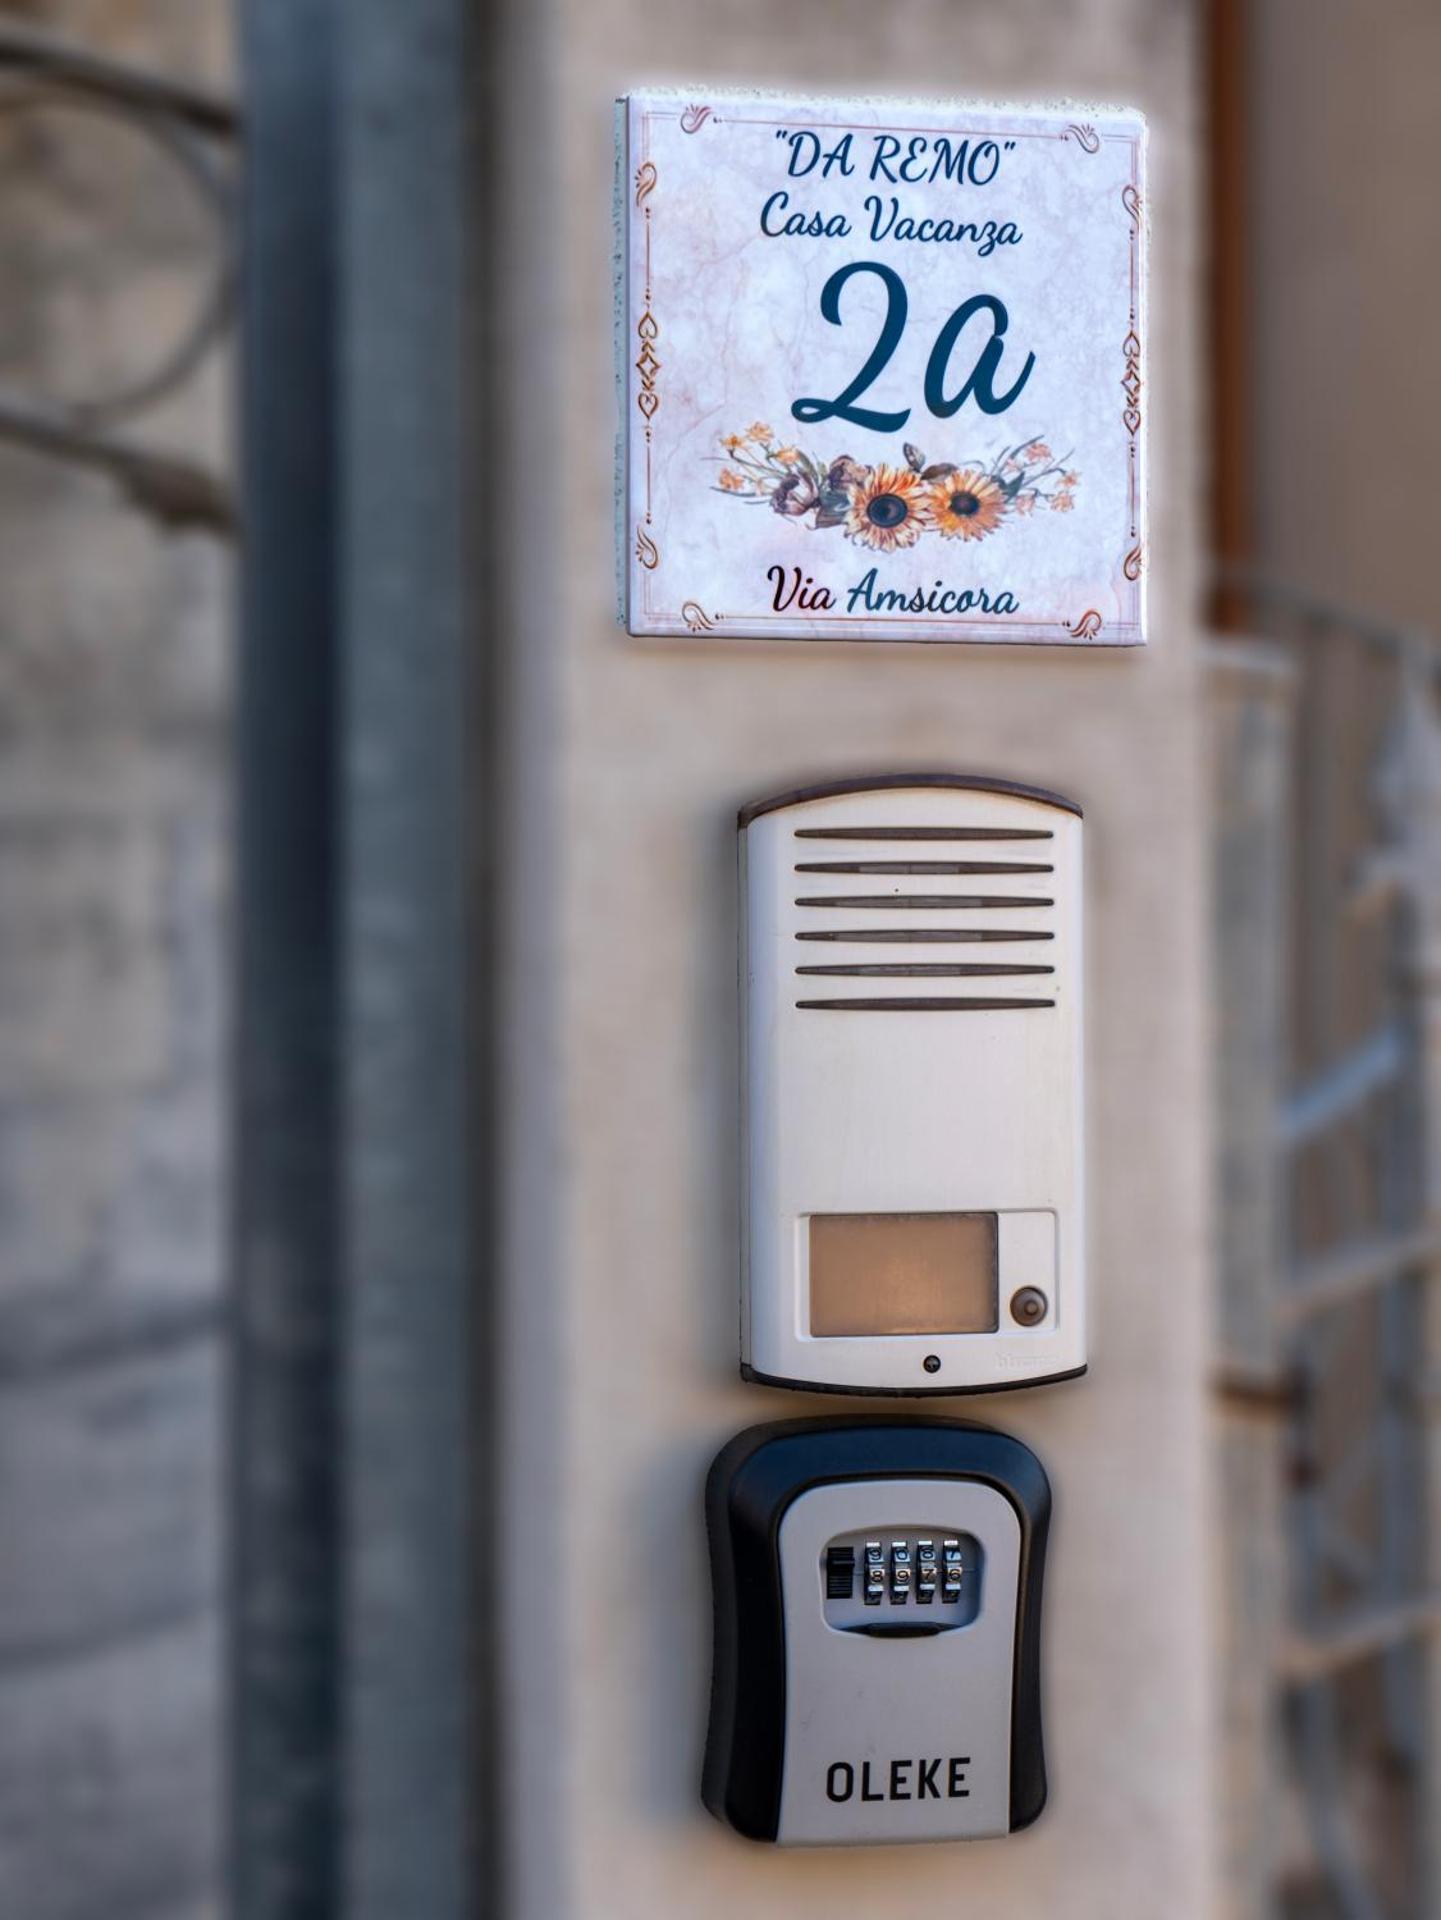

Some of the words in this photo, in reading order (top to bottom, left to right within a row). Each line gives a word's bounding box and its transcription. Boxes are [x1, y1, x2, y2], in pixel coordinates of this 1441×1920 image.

[775, 130, 855, 179] "DA
[869, 135, 1016, 186] REMO"
[760, 191, 852, 238] Casa
[863, 195, 1023, 257] Vacanza
[790, 261, 1036, 433] 2a
[767, 565, 837, 612] Via
[846, 567, 1020, 615] Amsicora
[826, 1756, 971, 1803] OLEKE
